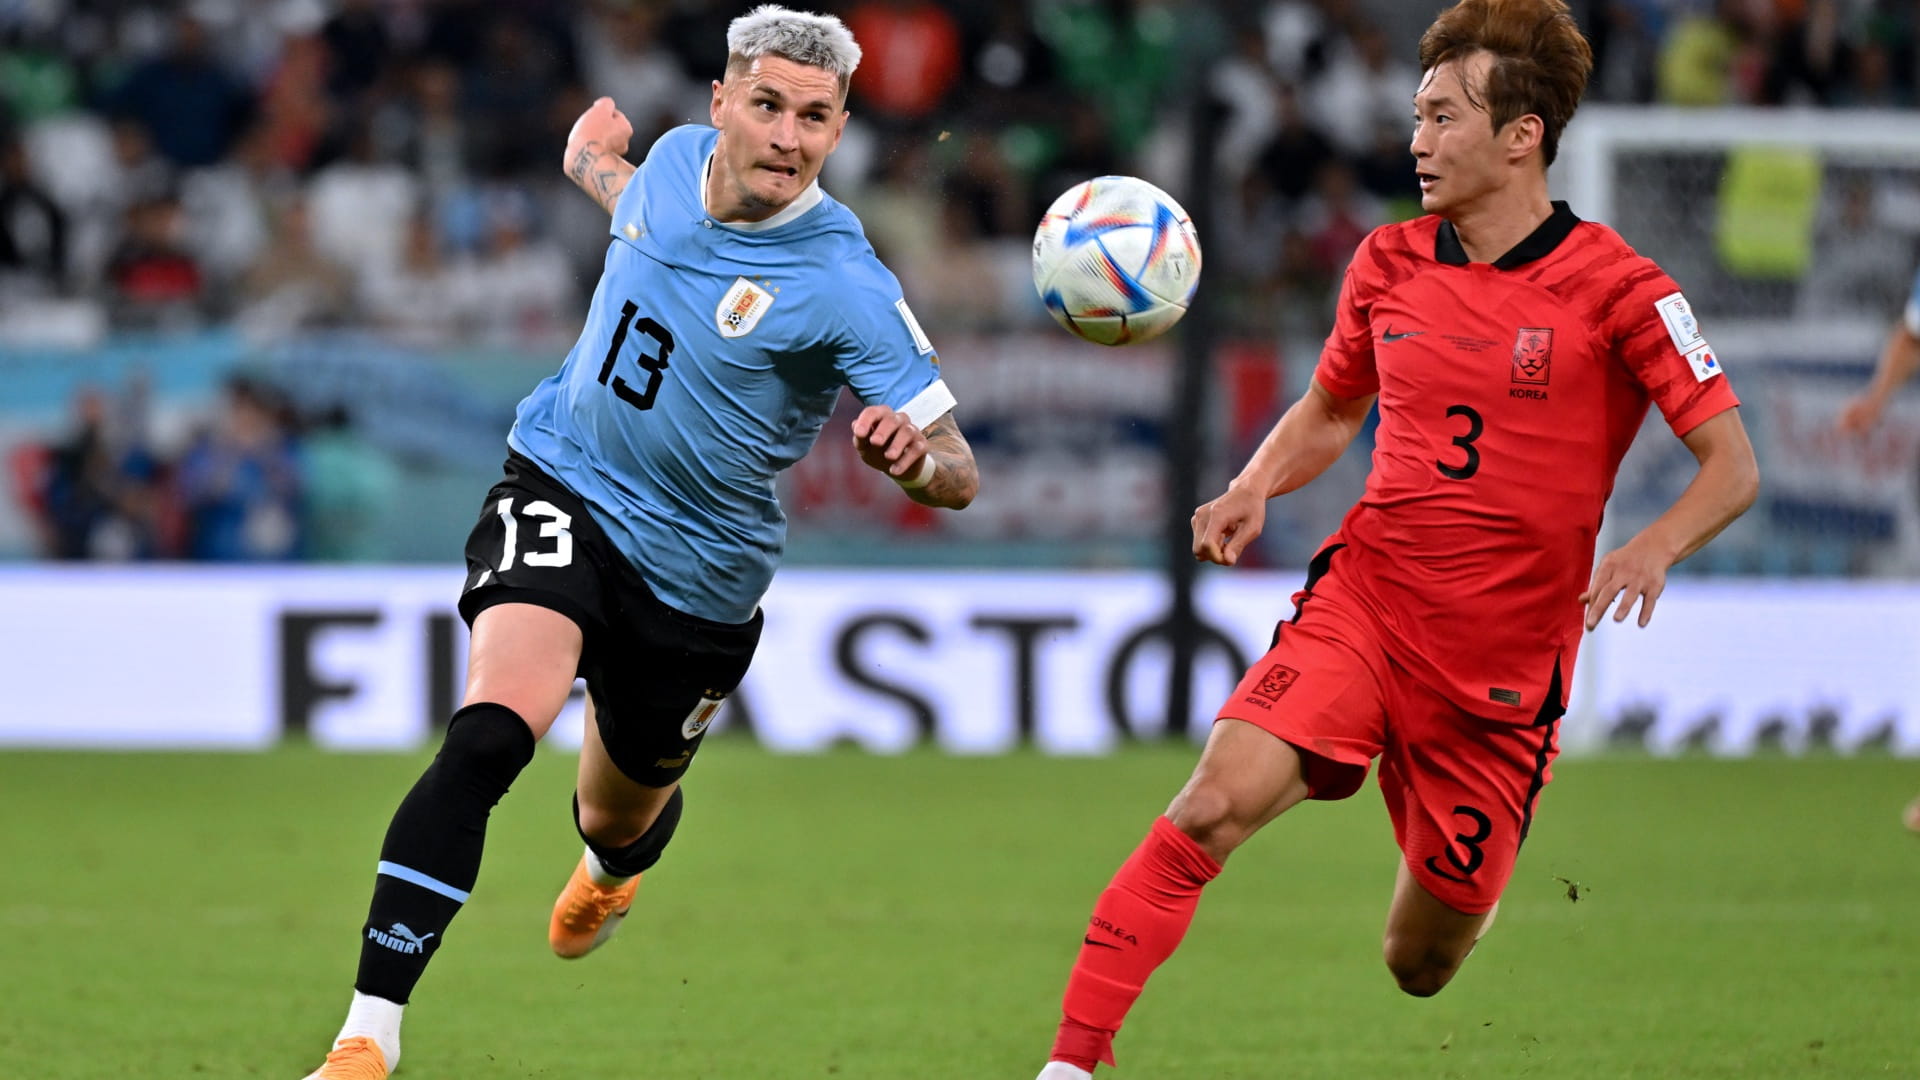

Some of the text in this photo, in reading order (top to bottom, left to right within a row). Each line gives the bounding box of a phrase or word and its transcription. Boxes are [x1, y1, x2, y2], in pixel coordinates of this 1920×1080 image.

[597, 300, 675, 411] 13
[1508, 387, 1548, 401] KOREA
[1436, 404, 1484, 480] 3
[497, 497, 573, 573] 13
[1444, 805, 1492, 875] 3
[368, 927, 417, 954] PUMA
